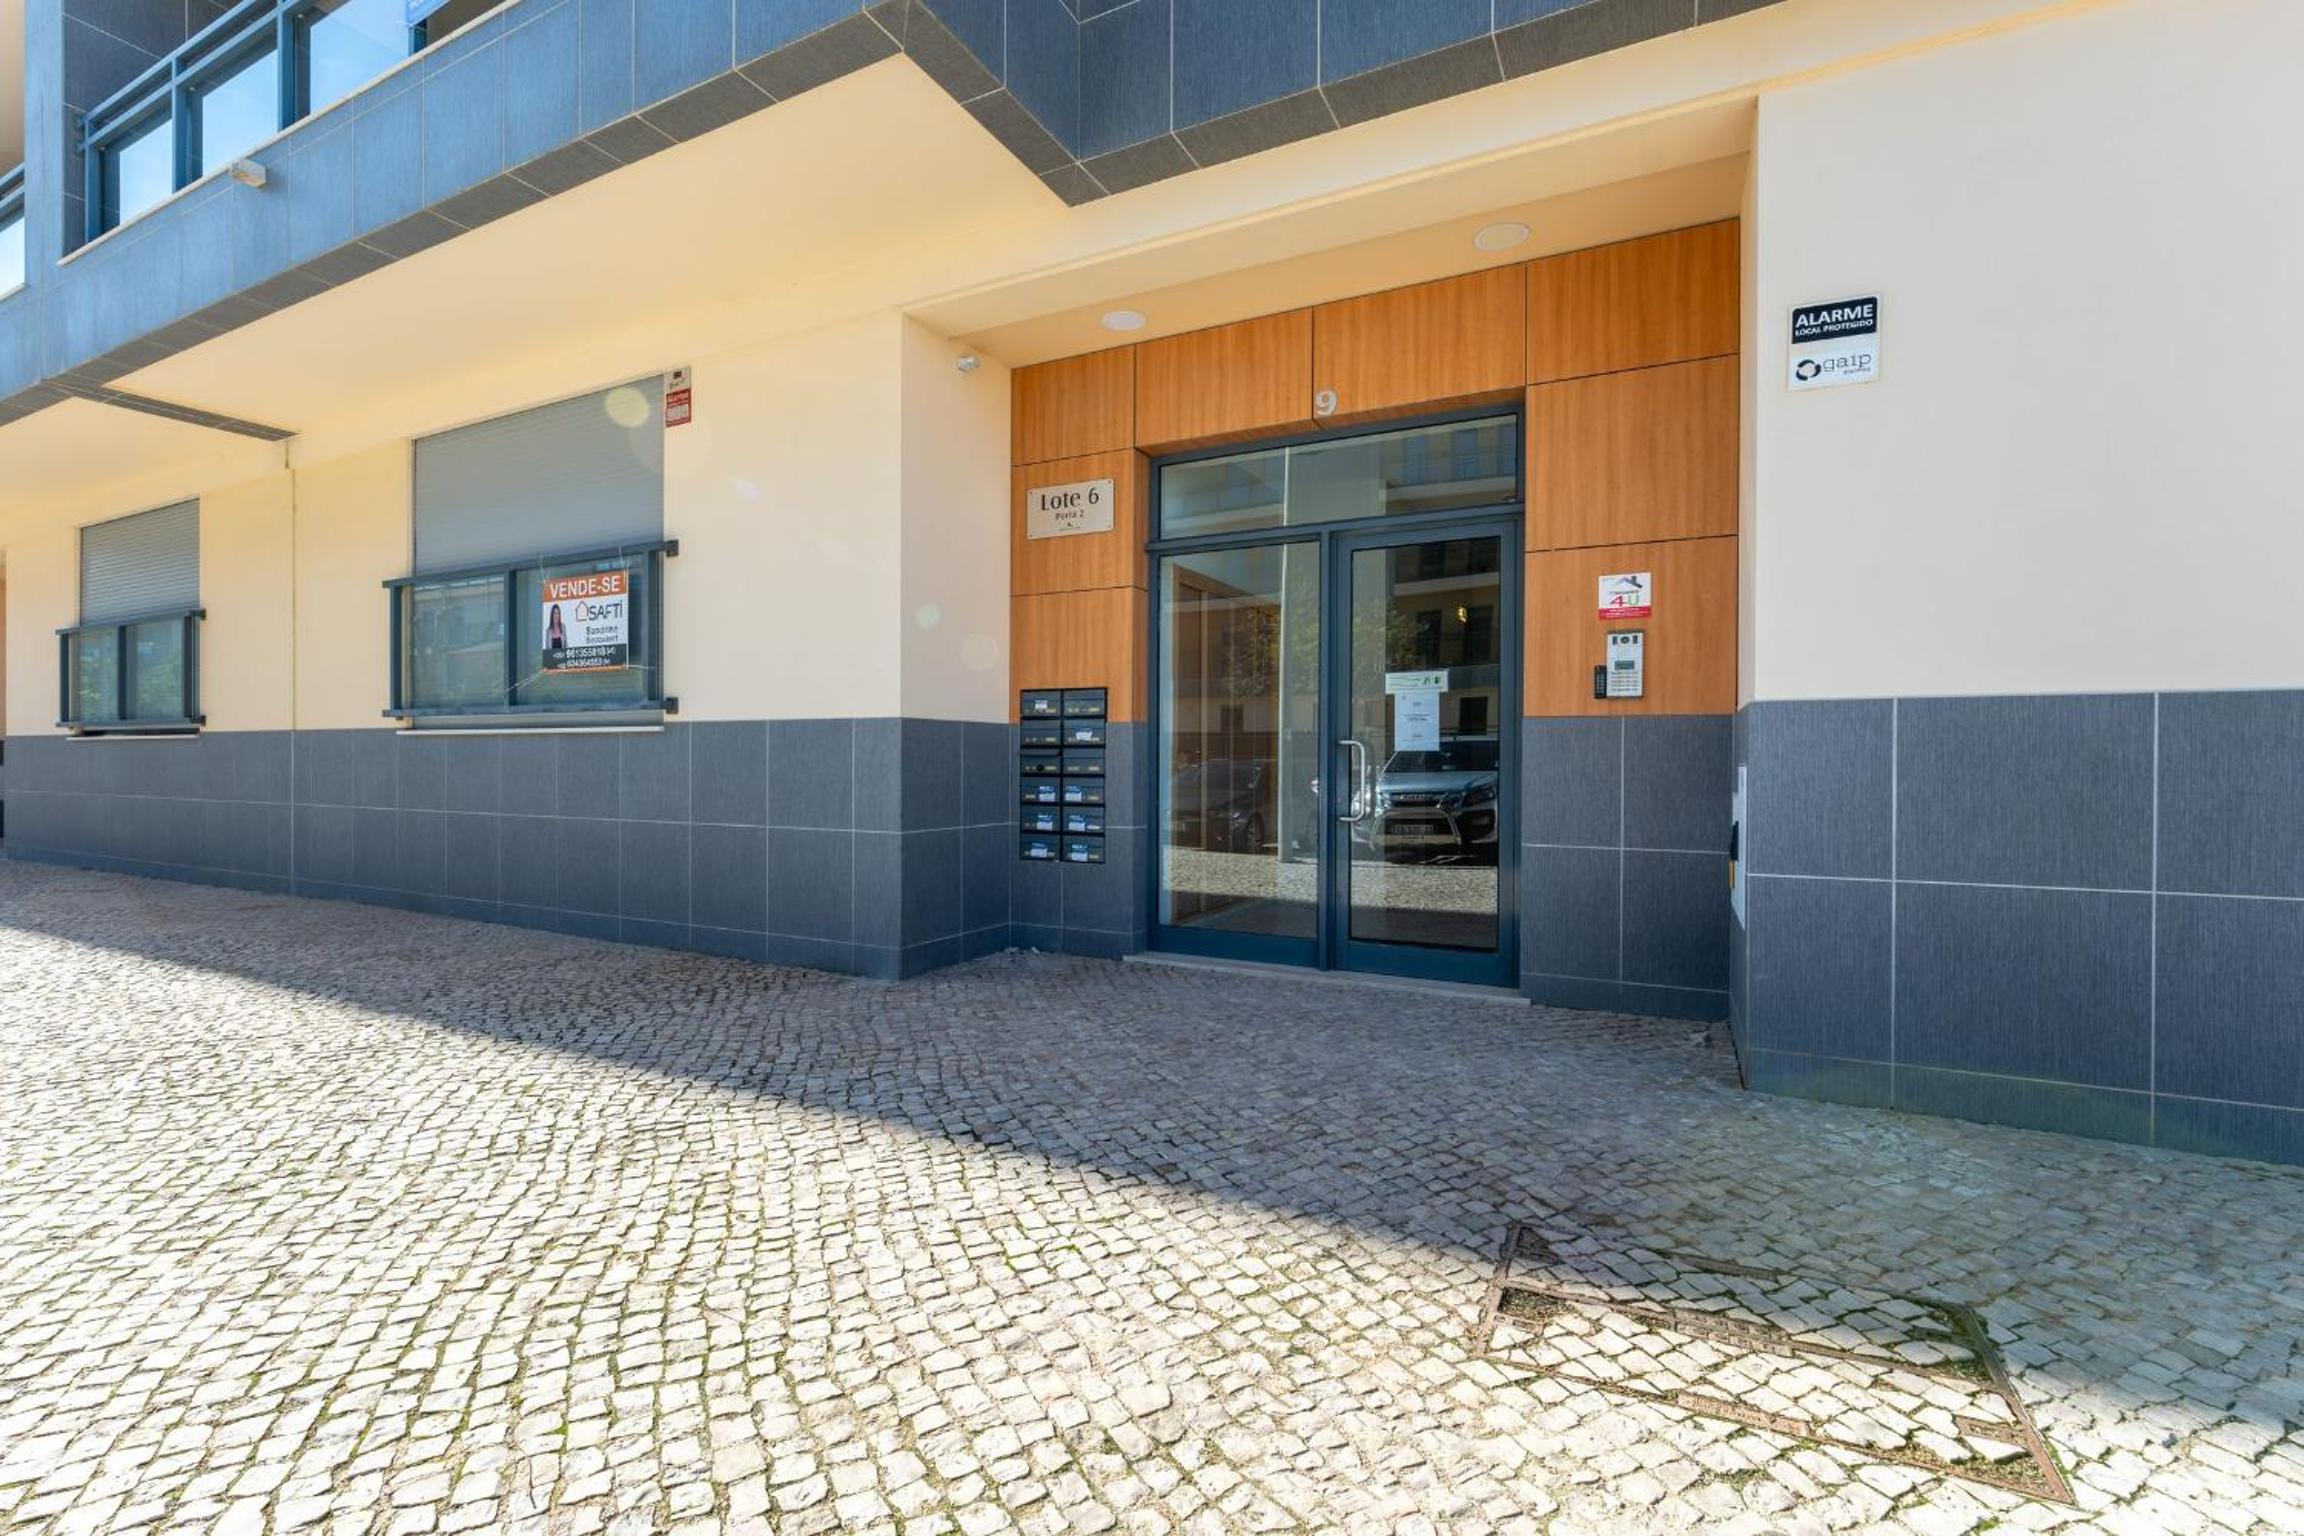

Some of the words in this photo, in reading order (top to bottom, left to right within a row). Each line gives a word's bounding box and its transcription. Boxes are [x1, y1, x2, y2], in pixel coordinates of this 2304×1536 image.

[1795, 304, 1874, 328] ALARME
[1795, 326, 1821, 336] LOCAL
[1822, 318, 1874, 332] PROTEGIDO
[1315, 390, 1337, 417] 9
[1041, 492, 1081, 511] Lote
[1088, 486, 1100, 505] 6
[549, 575, 621, 599] VENDE-SE
[588, 600, 623, 621] SAFTI
